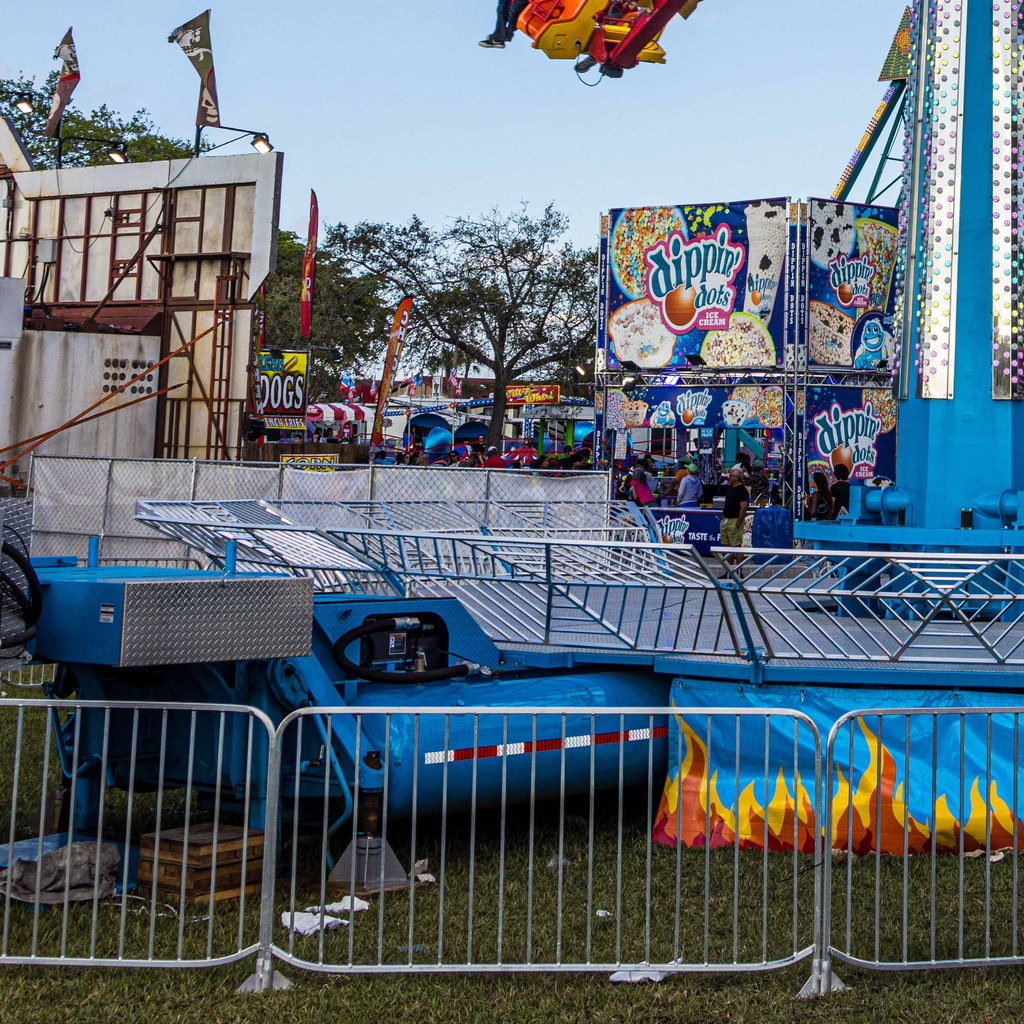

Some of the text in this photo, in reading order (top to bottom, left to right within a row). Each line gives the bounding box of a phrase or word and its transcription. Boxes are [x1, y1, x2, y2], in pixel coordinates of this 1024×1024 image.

[694, 283, 731, 309] dots
[852, 283, 869, 296] dots
[699, 318, 726, 326] CREAM
[259, 354, 285, 371] RESH
[260, 374, 304, 410] DOGS
[265, 417, 304, 428] ENCH FRIES
[852, 444, 875, 464] dots
[286, 457, 334, 469] CORN
[688, 532, 708, 541] TASTE
